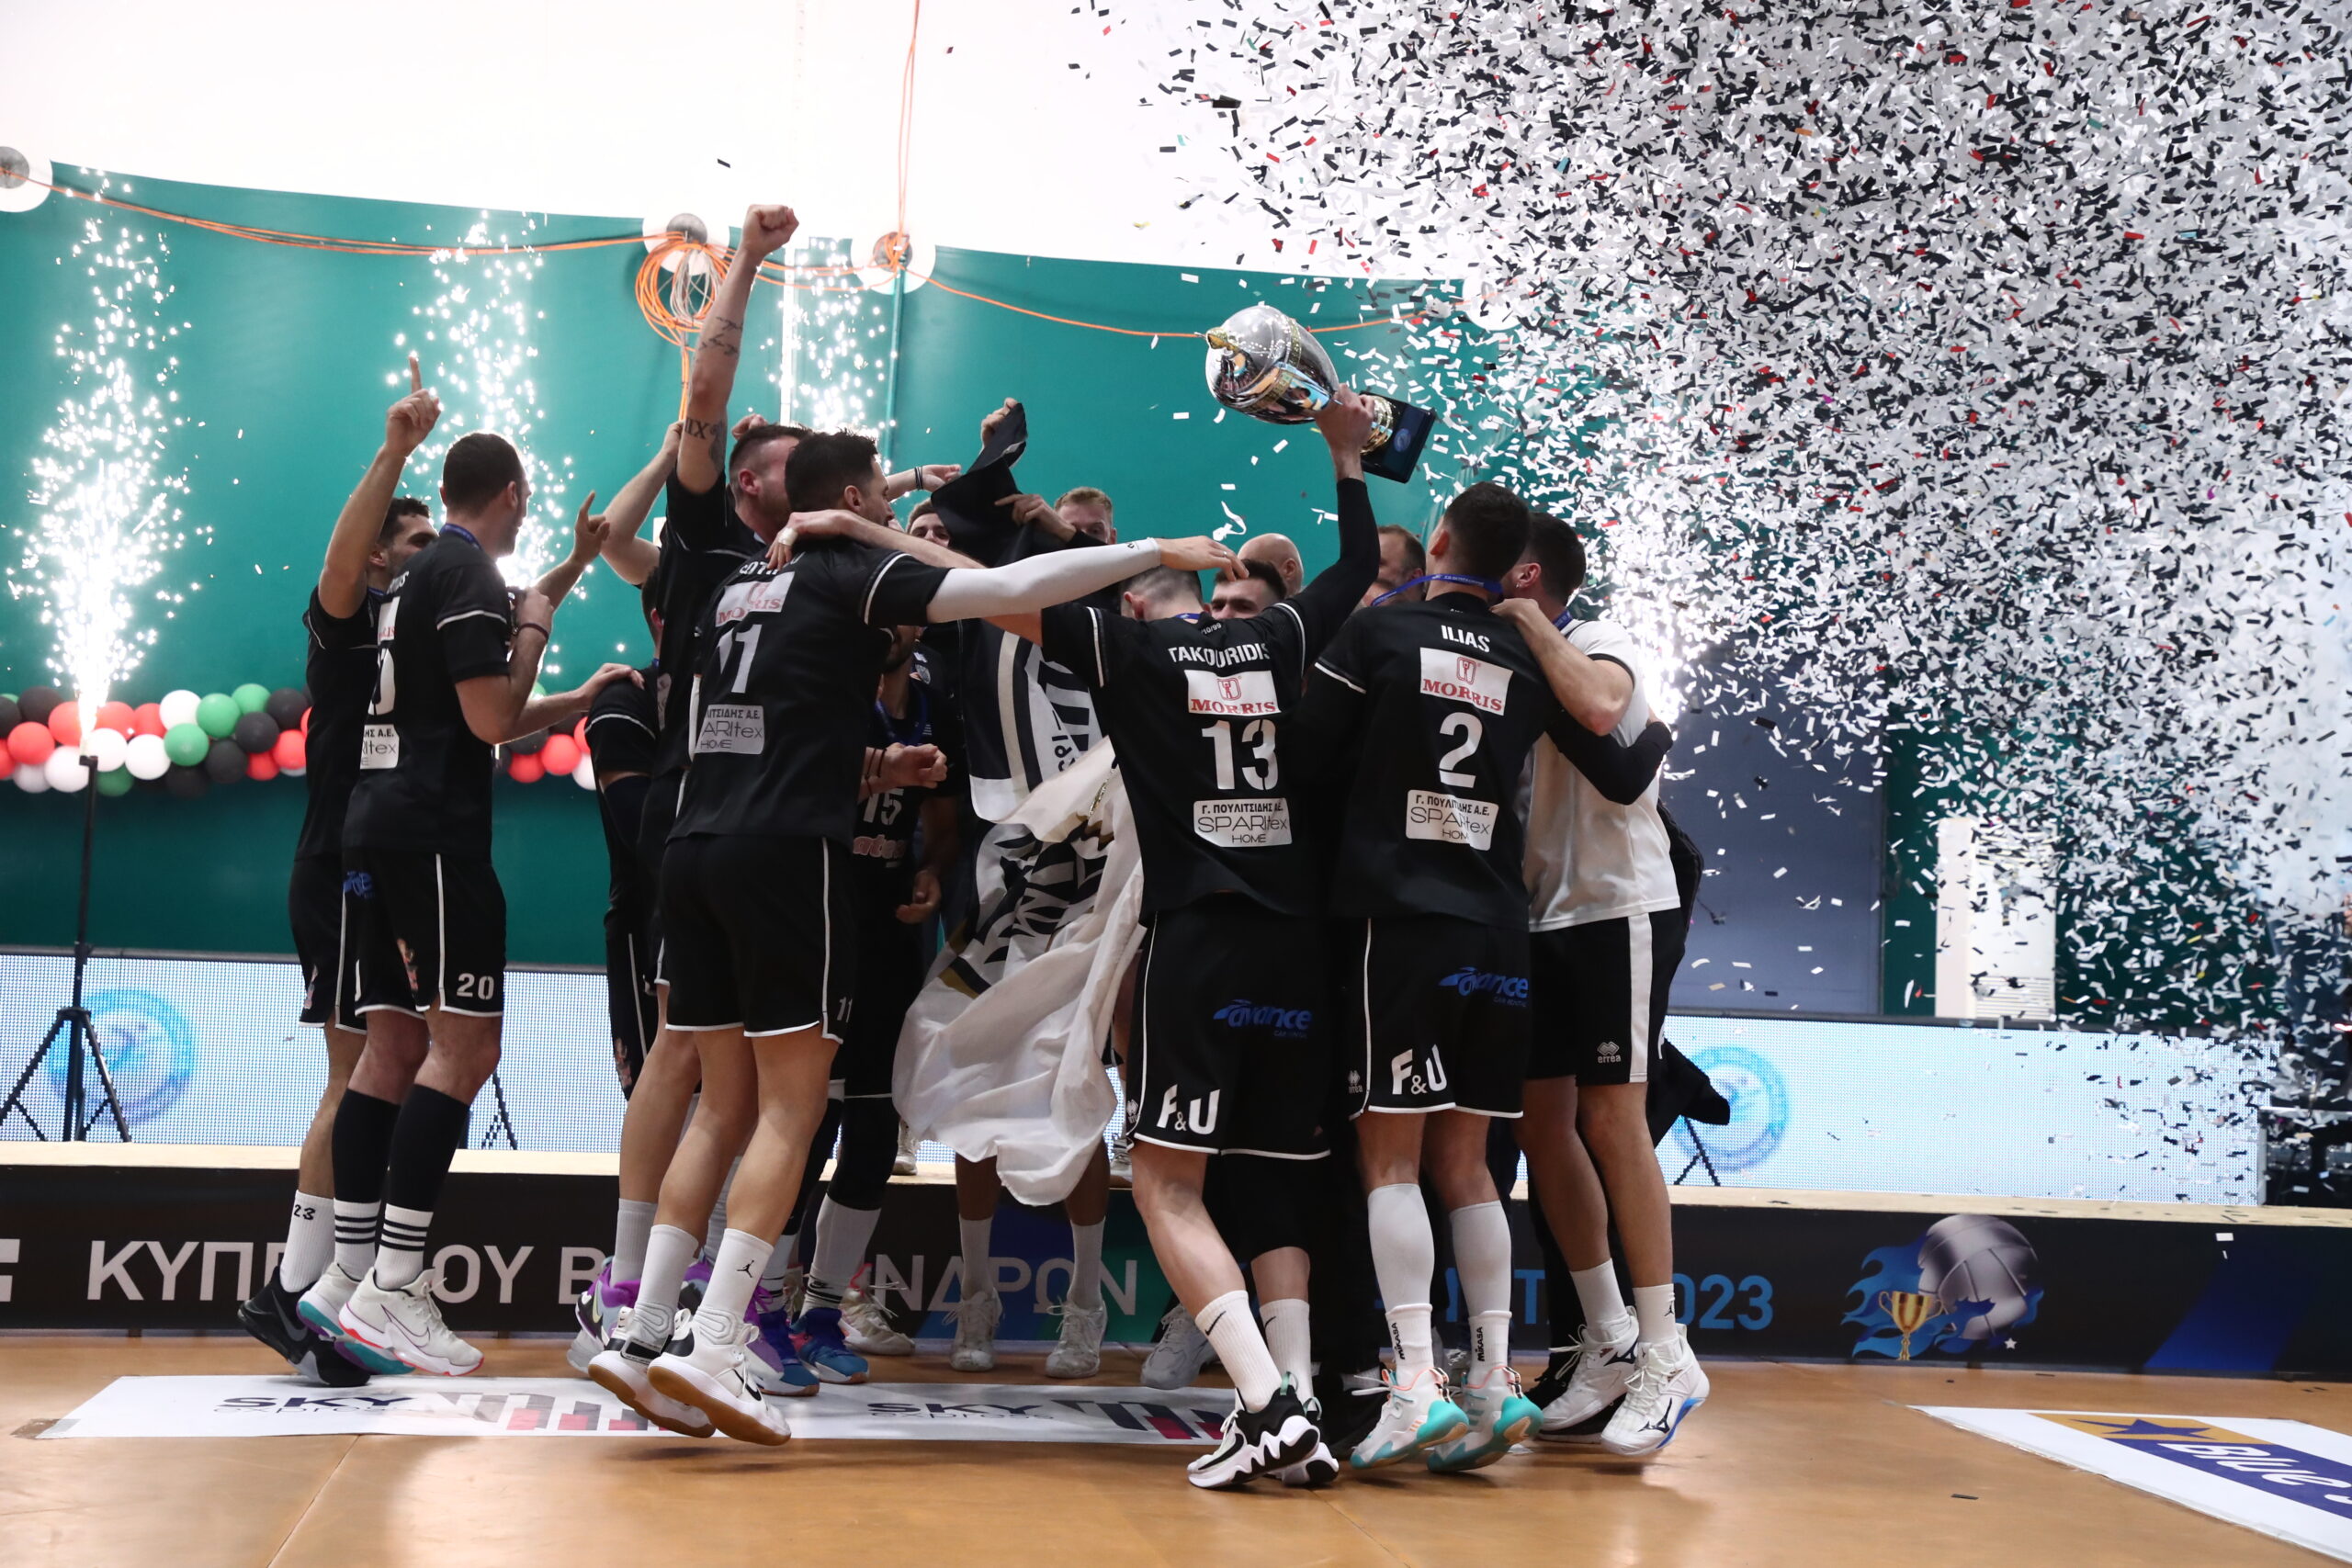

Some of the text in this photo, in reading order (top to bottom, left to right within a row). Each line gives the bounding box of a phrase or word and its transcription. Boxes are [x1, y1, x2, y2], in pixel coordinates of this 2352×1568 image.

[718, 599, 781, 624] MORIS
[1441, 625, 1490, 653] ILIAS
[1191, 698, 1277, 715] MORRIS
[1422, 678, 1503, 712] MORRIS
[1201, 718, 1279, 791] 13
[1438, 711, 1483, 788] 2
[863, 787, 905, 825] 15
[1232, 833, 1267, 844] HOME
[1442, 829, 1469, 840] HOM
[457, 973, 495, 1000] 20
[837, 996, 854, 1023] 11
[294, 1204, 316, 1221] 23
[87, 1240, 535, 1304] ΚΥΠΟΥ
[1673, 1273, 1774, 1330] 023
[217, 1396, 415, 1408] SKY
[867, 1403, 1042, 1415] SKY
